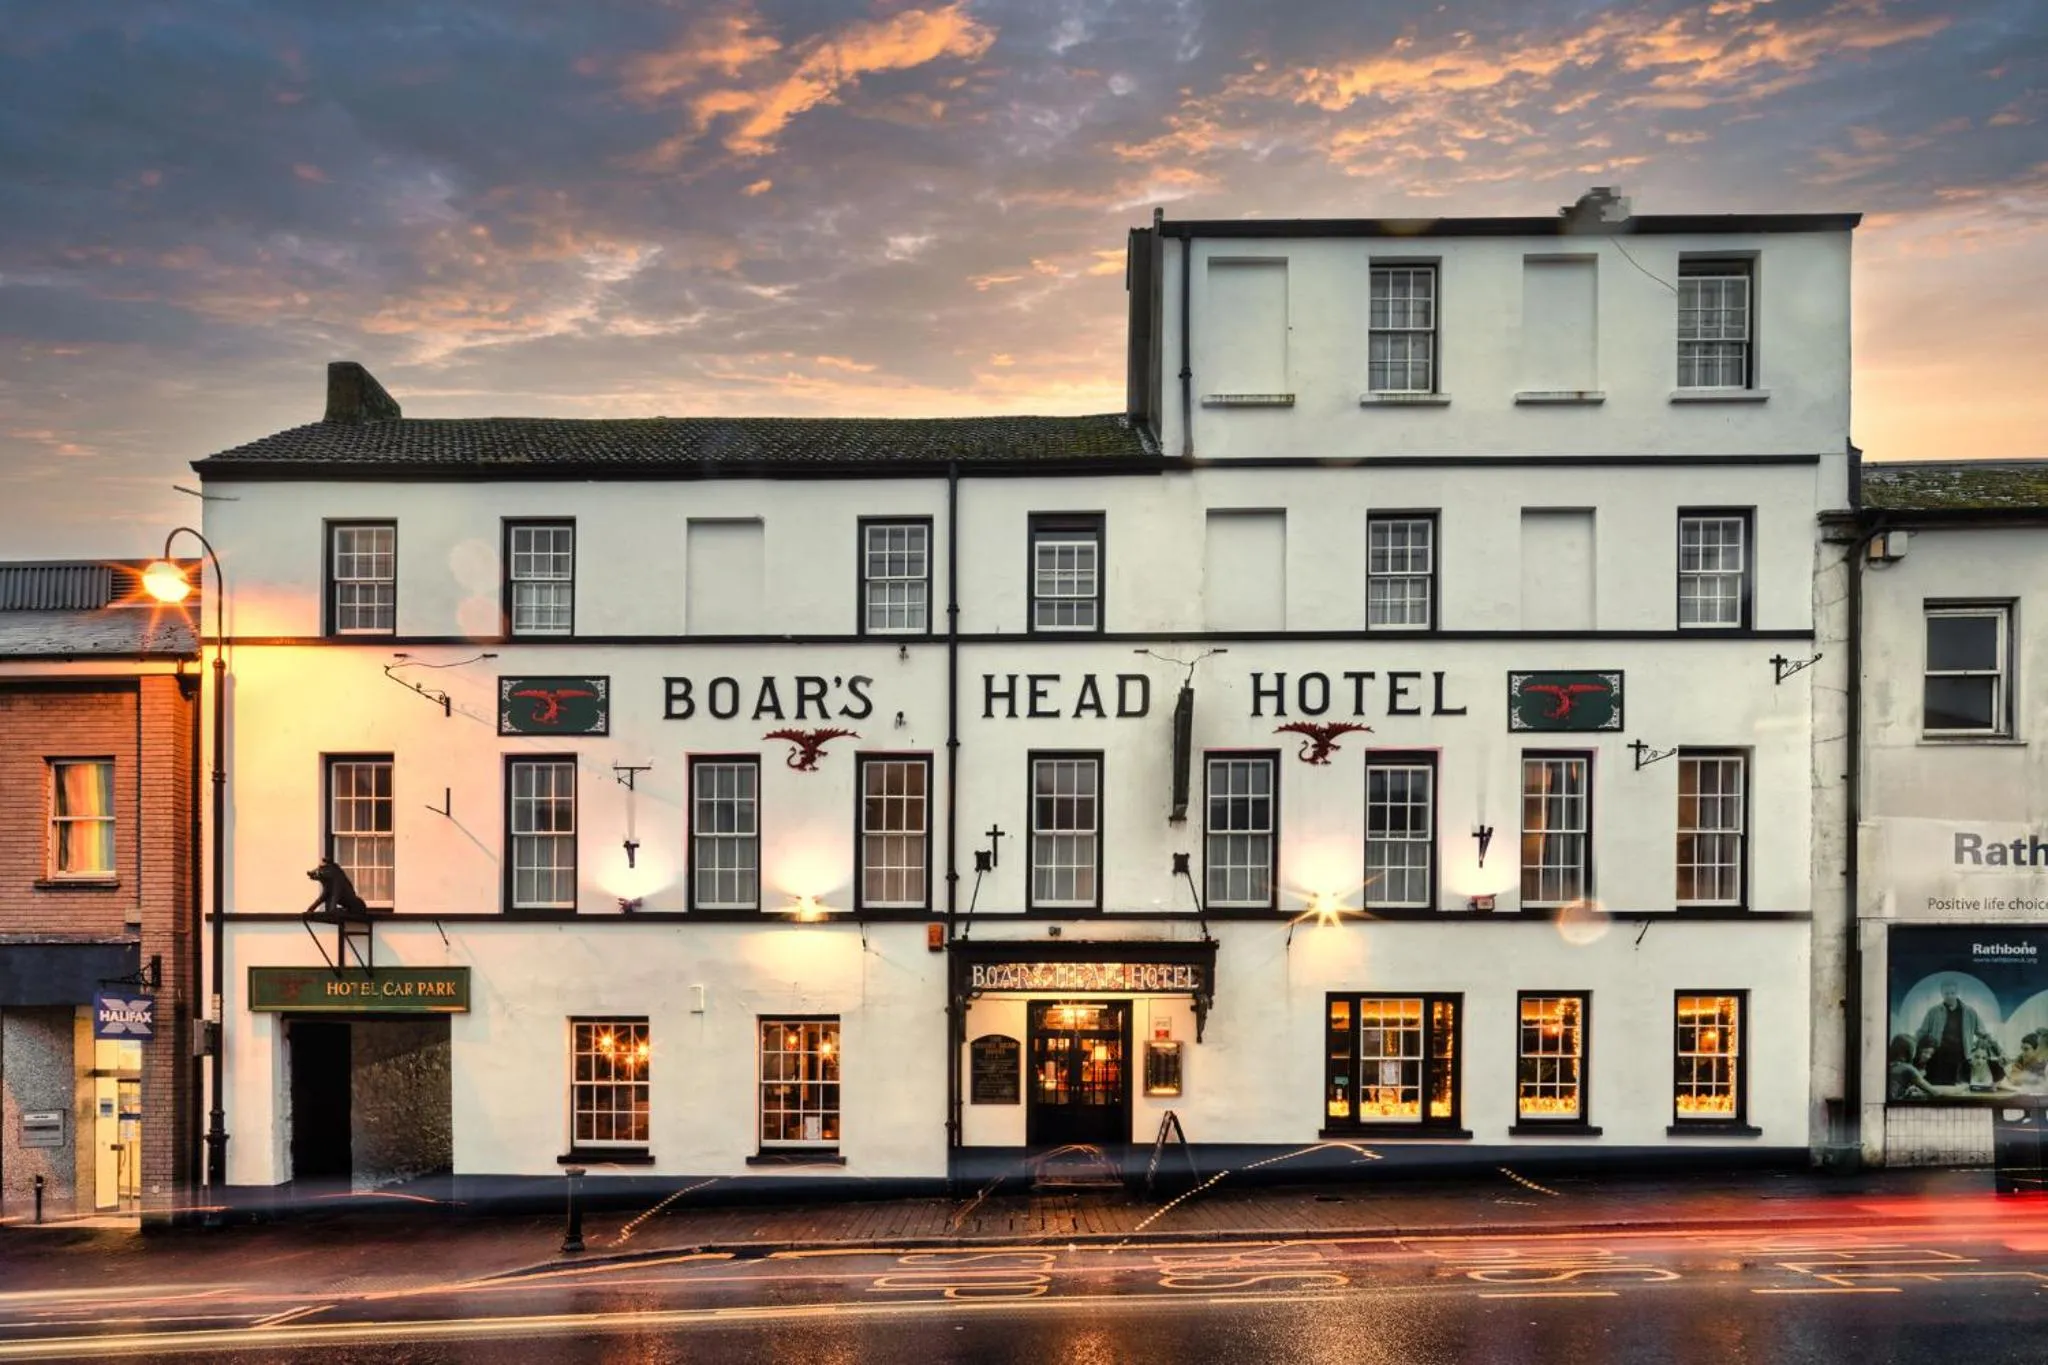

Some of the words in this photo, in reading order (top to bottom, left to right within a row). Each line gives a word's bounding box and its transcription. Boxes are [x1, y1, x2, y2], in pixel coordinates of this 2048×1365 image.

[662, 675, 874, 721] BOAR'S
[983, 673, 1150, 719] HEAD
[1250, 671, 1467, 718] HOTEL
[1954, 832, 2048, 866] Rath
[1927, 897, 1980, 910] Positive
[1984, 897, 2005, 910] life
[1972, 941, 2037, 955] Rathbone
[327, 982, 379, 996] HOTEL
[382, 981, 413, 996] CAR
[416, 981, 457, 996] PARK
[1130, 965, 1199, 989] HOTEL
[99, 1009, 152, 1023] HALIFAX
[865, 1252, 1058, 1299] STOP
[1153, 1250, 1353, 1290] BUS
